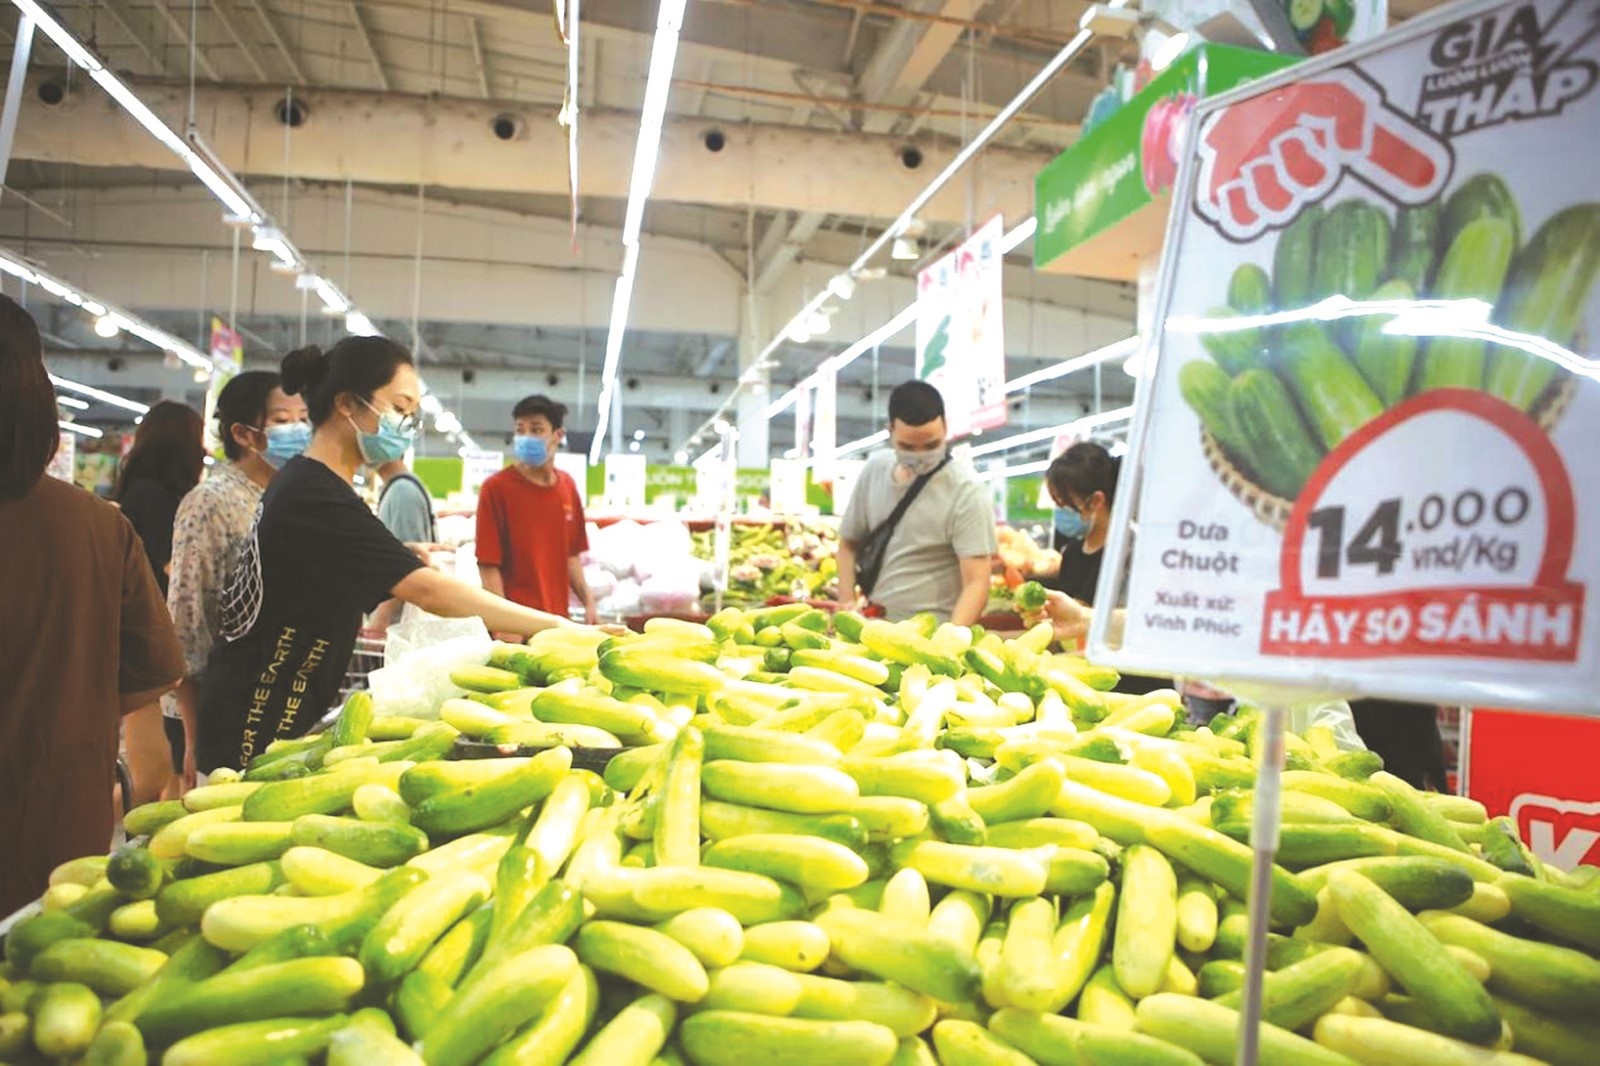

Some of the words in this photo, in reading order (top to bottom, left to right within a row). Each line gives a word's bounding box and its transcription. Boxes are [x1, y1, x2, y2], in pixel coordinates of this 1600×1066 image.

[1161, 548, 1239, 576] Chuột
[1178, 519, 1229, 541] Dưa
[1307, 485, 1531, 580] 14.000
[1269, 602, 1358, 645] HÃY
[1364, 605, 1411, 642] SO
[1417, 593, 1574, 646] SÁNH
[247, 688, 271, 724] THE
[260, 626, 297, 685] EARTH
[276, 696, 302, 733] THE
[292, 638, 331, 694] EARTH
